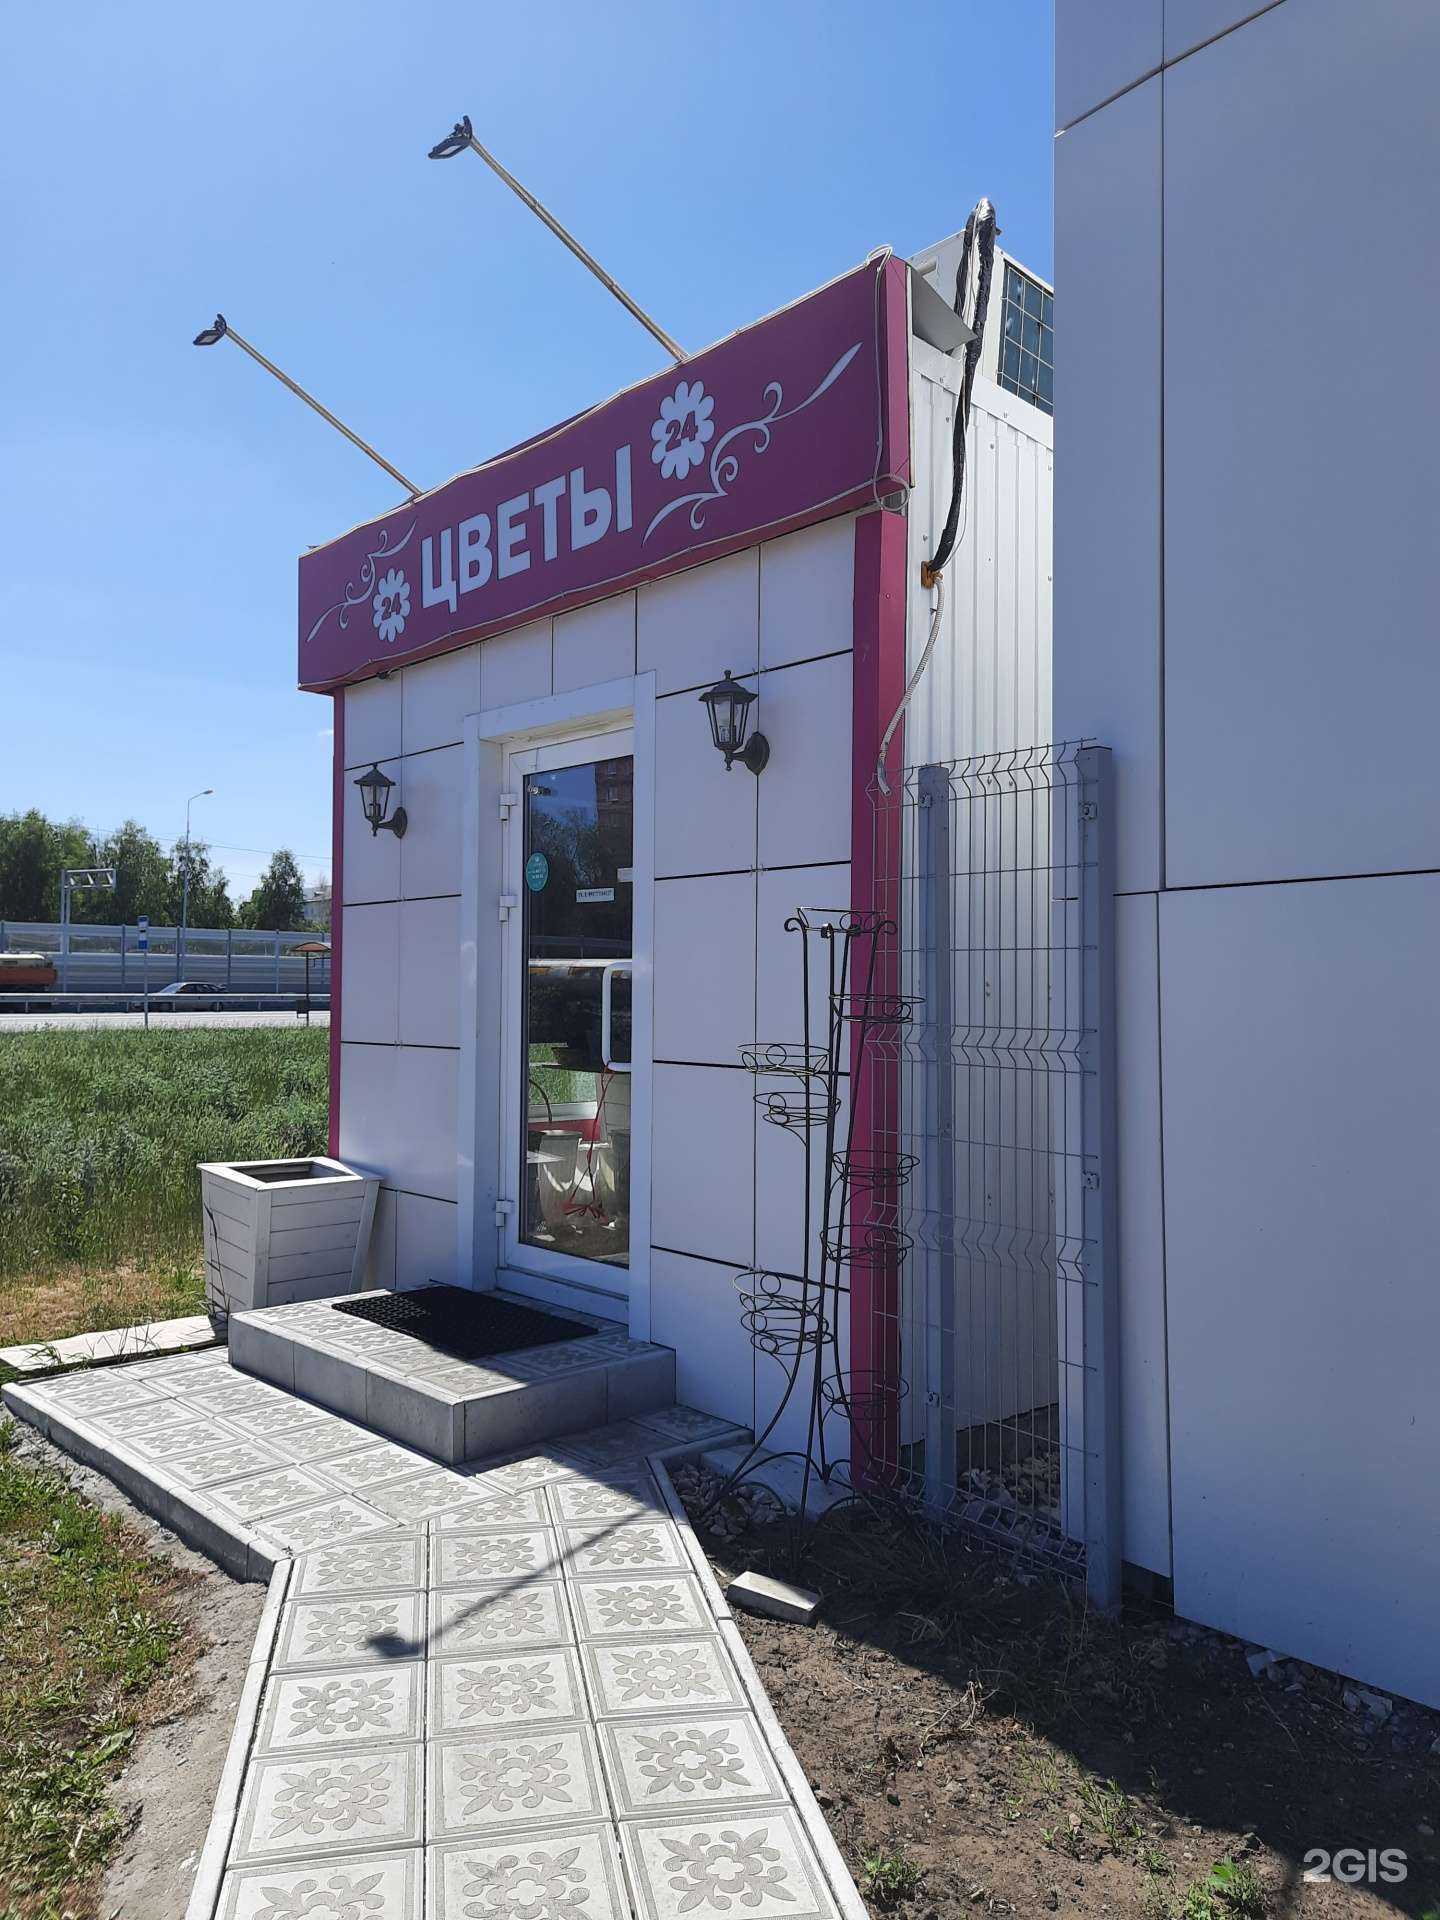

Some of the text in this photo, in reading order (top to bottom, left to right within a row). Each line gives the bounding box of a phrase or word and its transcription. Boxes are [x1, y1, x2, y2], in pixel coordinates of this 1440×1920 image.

[381, 410, 699, 621] 24 ЦВЕТЫ 24
